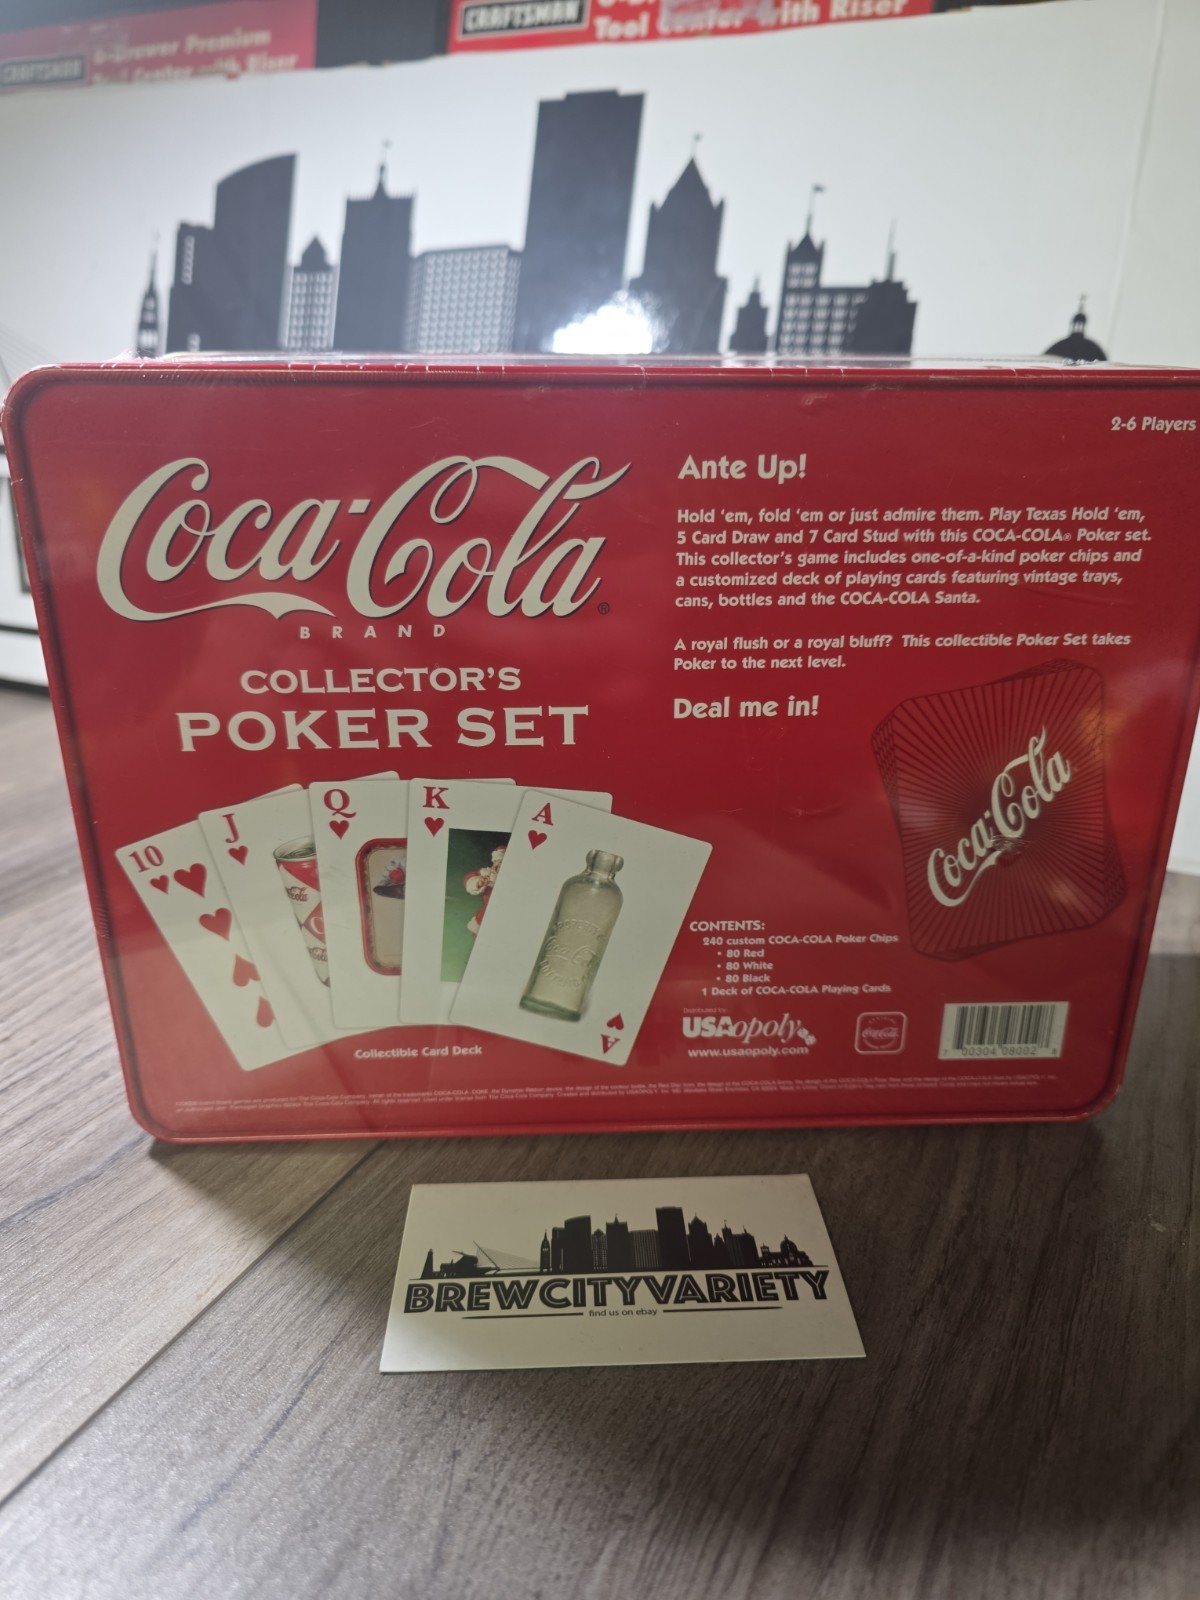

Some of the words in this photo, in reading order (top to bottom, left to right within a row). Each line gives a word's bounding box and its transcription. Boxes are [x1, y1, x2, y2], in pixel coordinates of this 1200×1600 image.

[463, 0, 580, 33] CRAFTSMAN
[594, 11, 649, 41] Tool
[1110, 416, 1137, 432] 2-6
[1141, 416, 1197, 434] Players
[677, 454, 748, 480] Ante
[757, 453, 808, 485] Up!
[677, 509, 715, 524] Hold
[758, 508, 791, 523] fold
[828, 511, 845, 523] or
[849, 507, 879, 525] just
[883, 507, 936, 522] admire
[941, 507, 984, 522] them.
[989, 507, 1022, 524] Play
[1026, 507, 1067, 521] Texas
[1071, 506, 1109, 521] Hold
[676, 531, 687, 545] 5
[692, 530, 727, 545] Card
[732, 530, 770, 545] Draw
[774, 529, 803, 544] and
[808, 529, 819, 543] 7
[823, 529, 858, 543] Card
[863, 528, 898, 543] Stud
[903, 528, 935, 543] with
[940, 528, 967, 542] this
[1077, 527, 1121, 542] Poker
[1124, 528, 1152, 542] set.
[676, 552, 706, 566] This
[797, 553, 839, 568] game
[844, 550, 906, 564] includes
[911, 549, 1015, 564] one-of-a-kind
[1019, 550, 1064, 565] poker
[1069, 549, 1108, 565] chips
[1113, 548, 1142, 563] and
[675, 576, 685, 587] a
[690, 572, 777, 587] customized
[782, 571, 820, 586] deck
[824, 571, 842, 585] of
[846, 571, 902, 588] playing
[905, 570, 947, 585] cards
[952, 570, 1018, 587] featuring
[1023, 570, 1077, 586] vintage
[1082, 571, 1123, 586] trays,
[675, 594, 714, 610] cans,
[718, 593, 773, 607] bottles
[777, 592, 806, 606] and
[811, 592, 836, 606] the
[840, 591, 930, 606] COCA-COLA
[935, 591, 981, 605] Santa.
[299, 624, 447, 640] BRAND
[674, 638, 687, 651] A
[691, 636, 727, 653] royal
[733, 636, 768, 650] flush
[773, 639, 789, 650] or
[793, 639, 803, 650] a
[807, 635, 844, 653] royal
[849, 634, 893, 649] bluff?
[902, 634, 931, 648] This
[935, 632, 1012, 647] collectible
[1016, 633, 1059, 647] Poker
[1063, 633, 1088, 647] Set
[1091, 632, 1132, 646] takes
[673, 657, 716, 670] Poker
[721, 658, 737, 670] to
[742, 656, 766, 669] the
[770, 656, 803, 669] next
[807, 655, 846, 669] level.
[673, 696, 730, 719] Deal
[739, 699, 779, 717] me
[787, 695, 819, 716] in!
[175, 706, 433, 752] POKER
[456, 704, 590, 748] SET
[323, 788, 357, 819] Q
[422, 785, 450, 809] K
[531, 802, 554, 827] A
[927, 725, 1072, 907] Coca-Cola
[221, 812, 240, 844] J
[128, 845, 165, 873] 10
[689, 919, 766, 932] CONTENTS:
[702, 936, 723, 946] 240
[726, 936, 766, 946] custom
[768, 935, 833, 945] COCA-COLA
[835, 934, 867, 944] Poker
[869, 933, 898, 945] Chips
[726, 949, 740, 959] 80
[743, 948, 765, 958] Red
[725, 961, 740, 971] 80
[743, 960, 774, 971] White
[725, 974, 739, 984] 80
[742, 973, 770, 983] Black
[701, 987, 708, 997] 1
[711, 986, 738, 997] Deck
[741, 985, 753, 996] of
[755, 984, 819, 995] COCA-COLA
[821, 983, 859, 995] Playing
[862, 983, 892, 994] Cards
[682, 1013, 803, 1045] USAopoly
[354, 1047, 419, 1060] Collectible
[422, 1046, 449, 1057] Card
[452, 1045, 482, 1056] Deck
[688, 1045, 810, 1058] www.usaopoly.com
[403, 1270, 830, 1314] BREWCITYVARIETY
[589, 1308, 606, 1318] find
[636, 1308, 658, 1318] ebay
